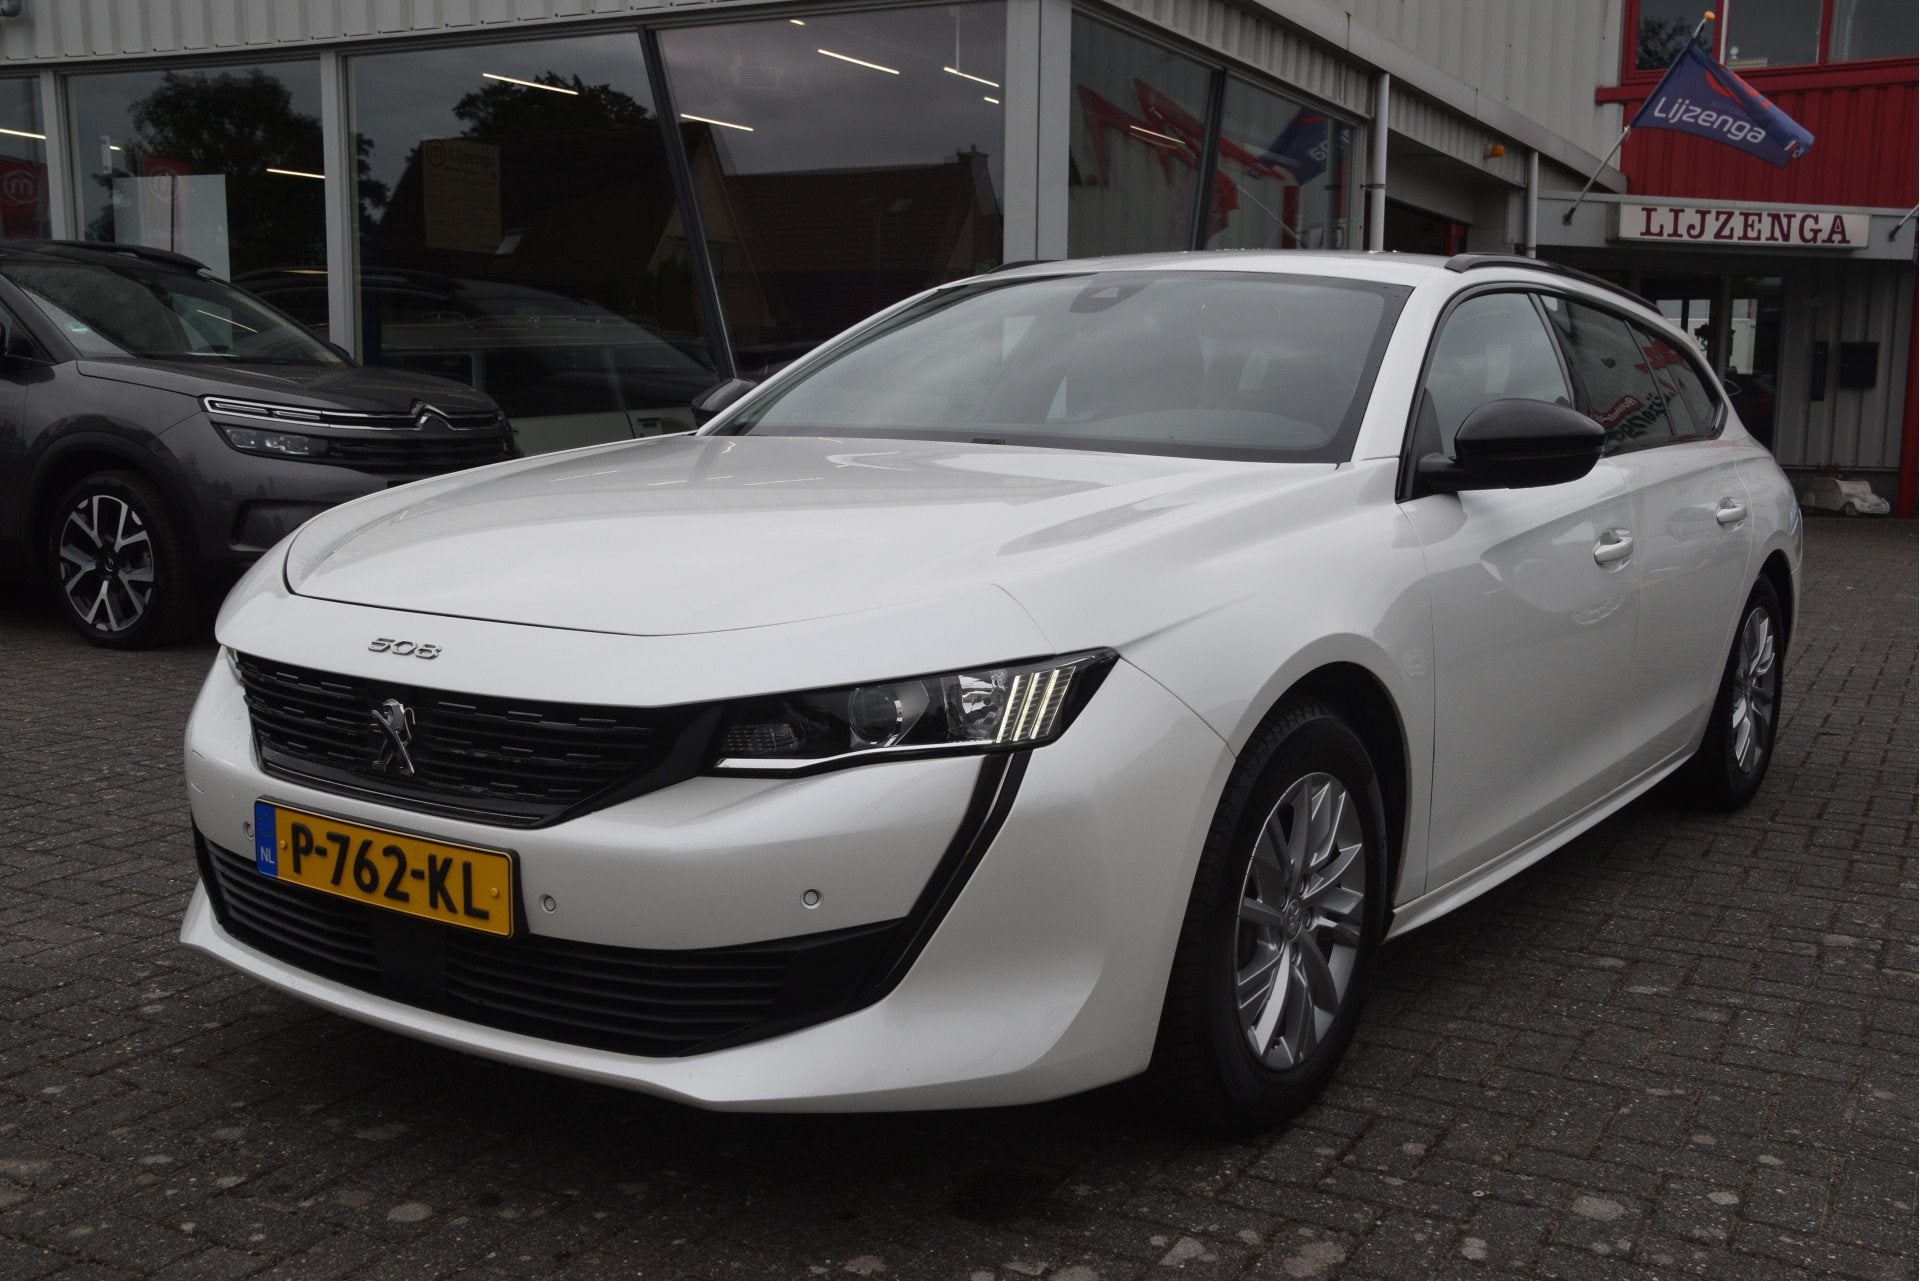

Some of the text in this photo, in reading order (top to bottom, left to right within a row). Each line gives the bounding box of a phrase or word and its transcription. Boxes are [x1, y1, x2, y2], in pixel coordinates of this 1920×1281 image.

[1653, 97, 1767, 144] Lijzenga
[449, 145, 496, 169] Lijzenga
[1640, 207, 1850, 244] LIJZENGA
[368, 637, 442, 660] 508
[260, 845, 275, 865] NL
[291, 822, 490, 920] P-762-KL
